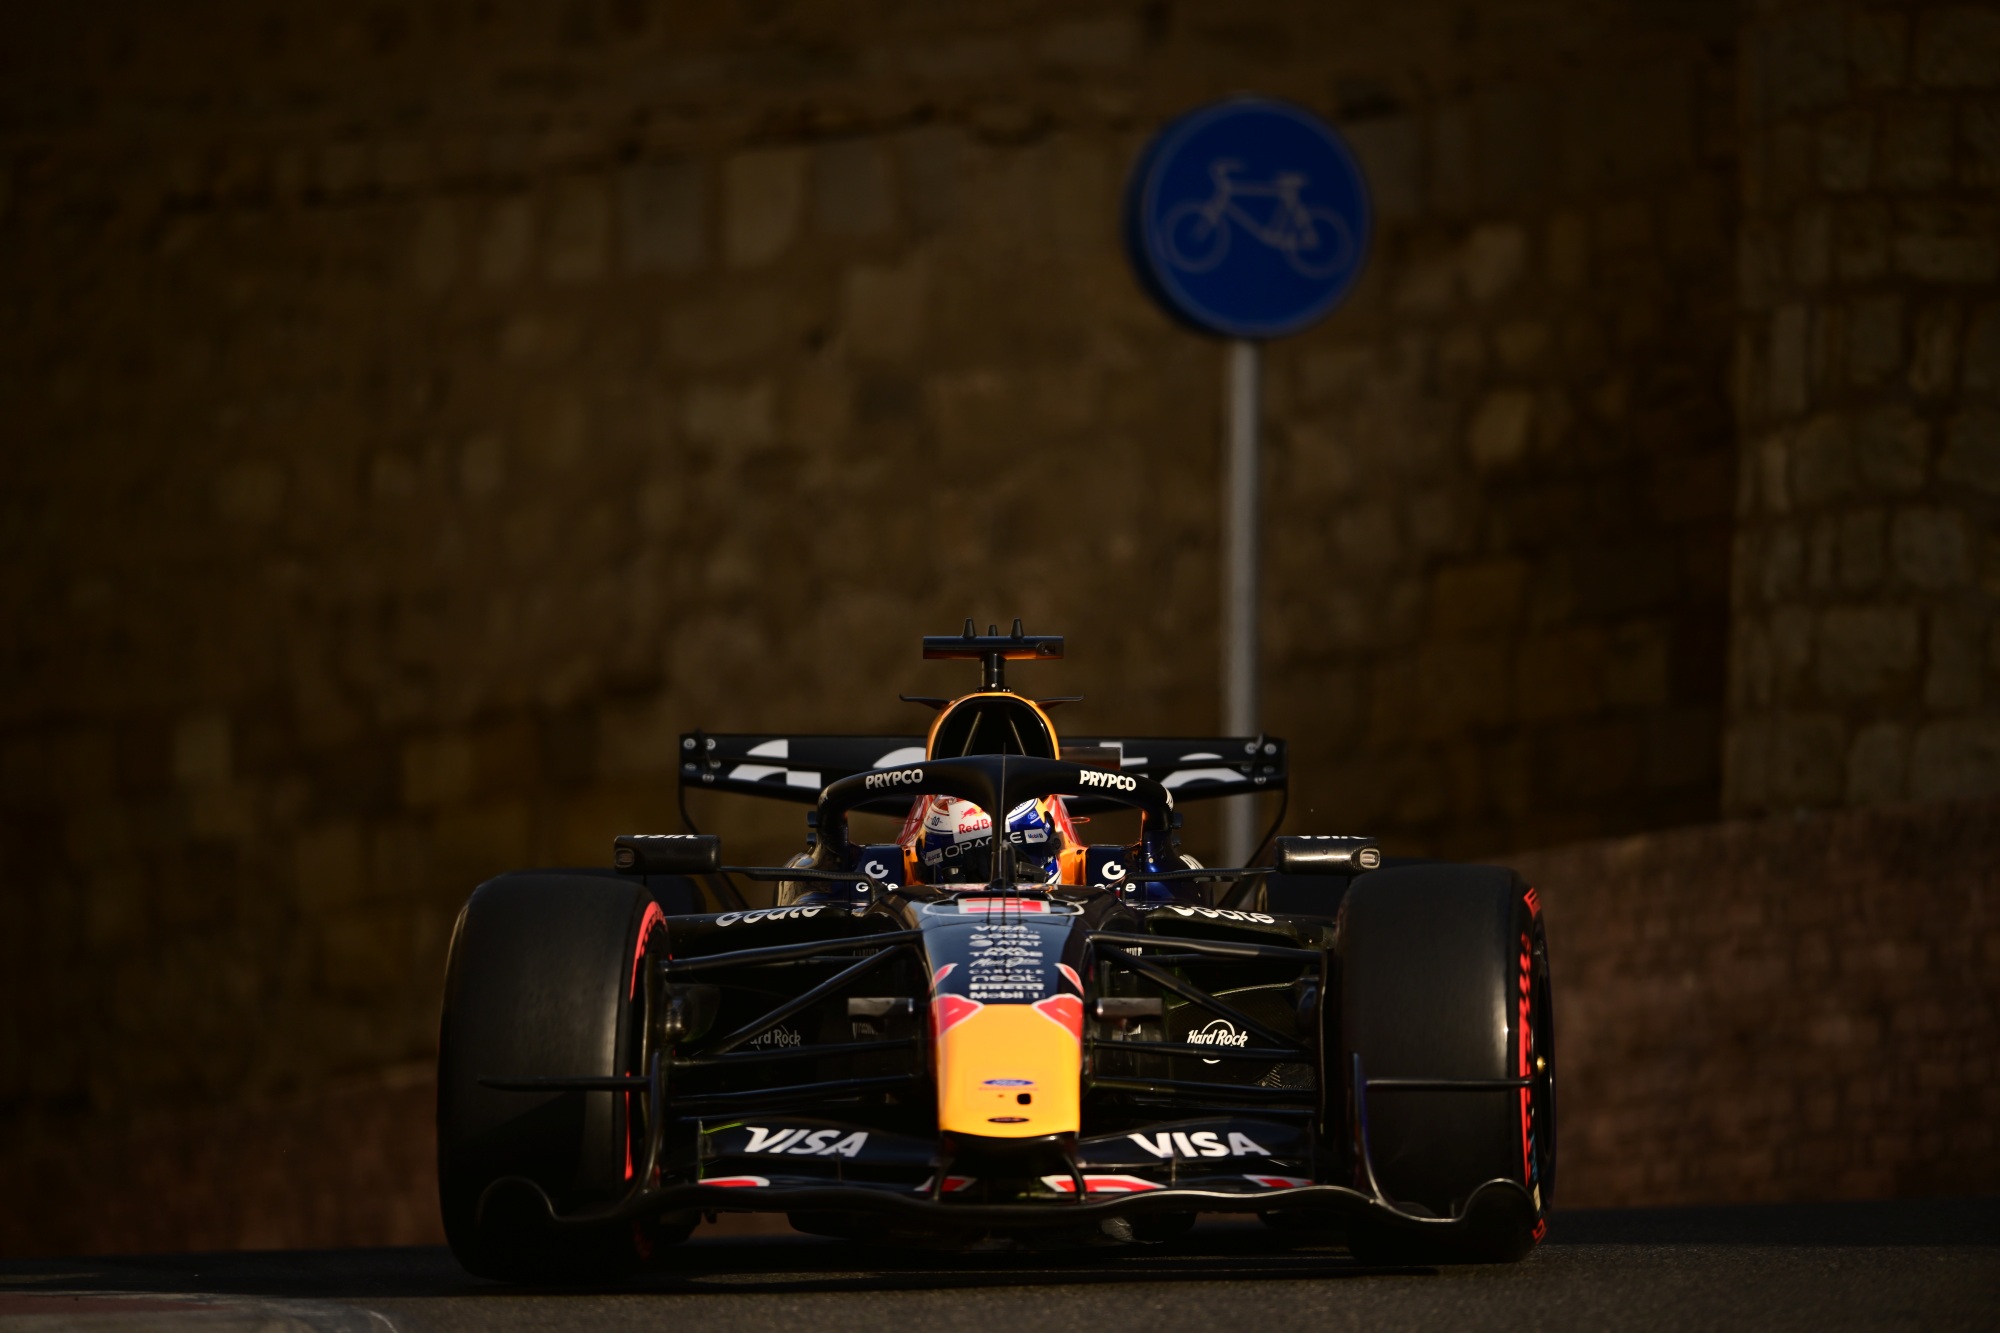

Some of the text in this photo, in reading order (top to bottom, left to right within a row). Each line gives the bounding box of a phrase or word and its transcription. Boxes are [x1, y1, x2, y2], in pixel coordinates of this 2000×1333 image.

[865, 768, 924, 790] PRYPCO
[1079, 769, 1137, 792] PRYPCO
[958, 819, 981, 835] Red
[969, 991, 1024, 999] Mobil
[773, 1028, 802, 1048] Rock
[1186, 1028, 1248, 1048] Hard Rock
[743, 1126, 869, 1158] VISA
[1126, 1131, 1272, 1159] VISA
